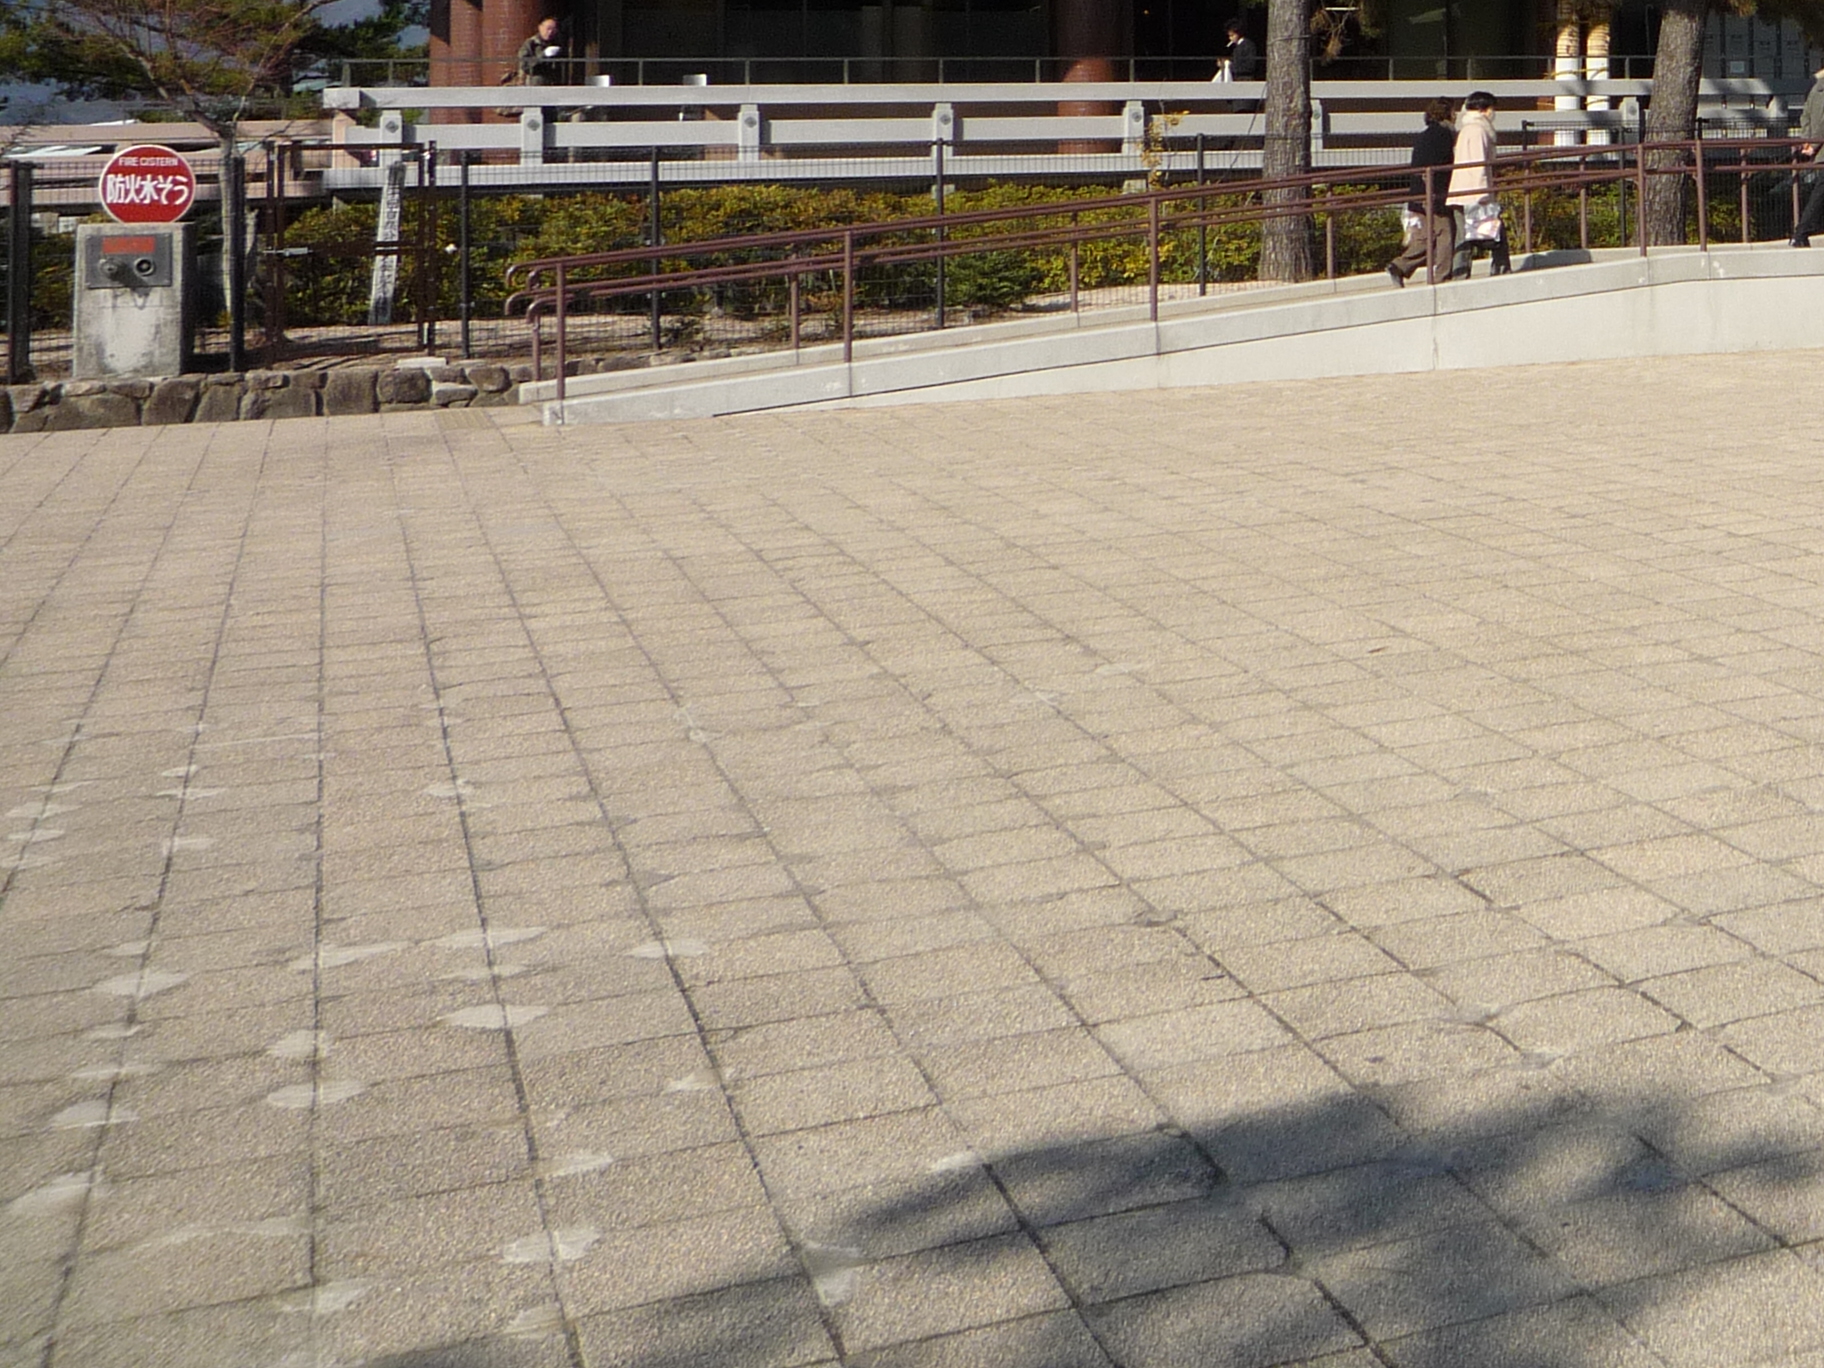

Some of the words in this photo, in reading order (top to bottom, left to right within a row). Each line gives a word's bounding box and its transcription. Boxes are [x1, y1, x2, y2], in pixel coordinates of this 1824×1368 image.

[119, 156, 138, 167] FIRE
[140, 156, 178, 167] CISTERN
[106, 173, 189, 205] 防火水そう
